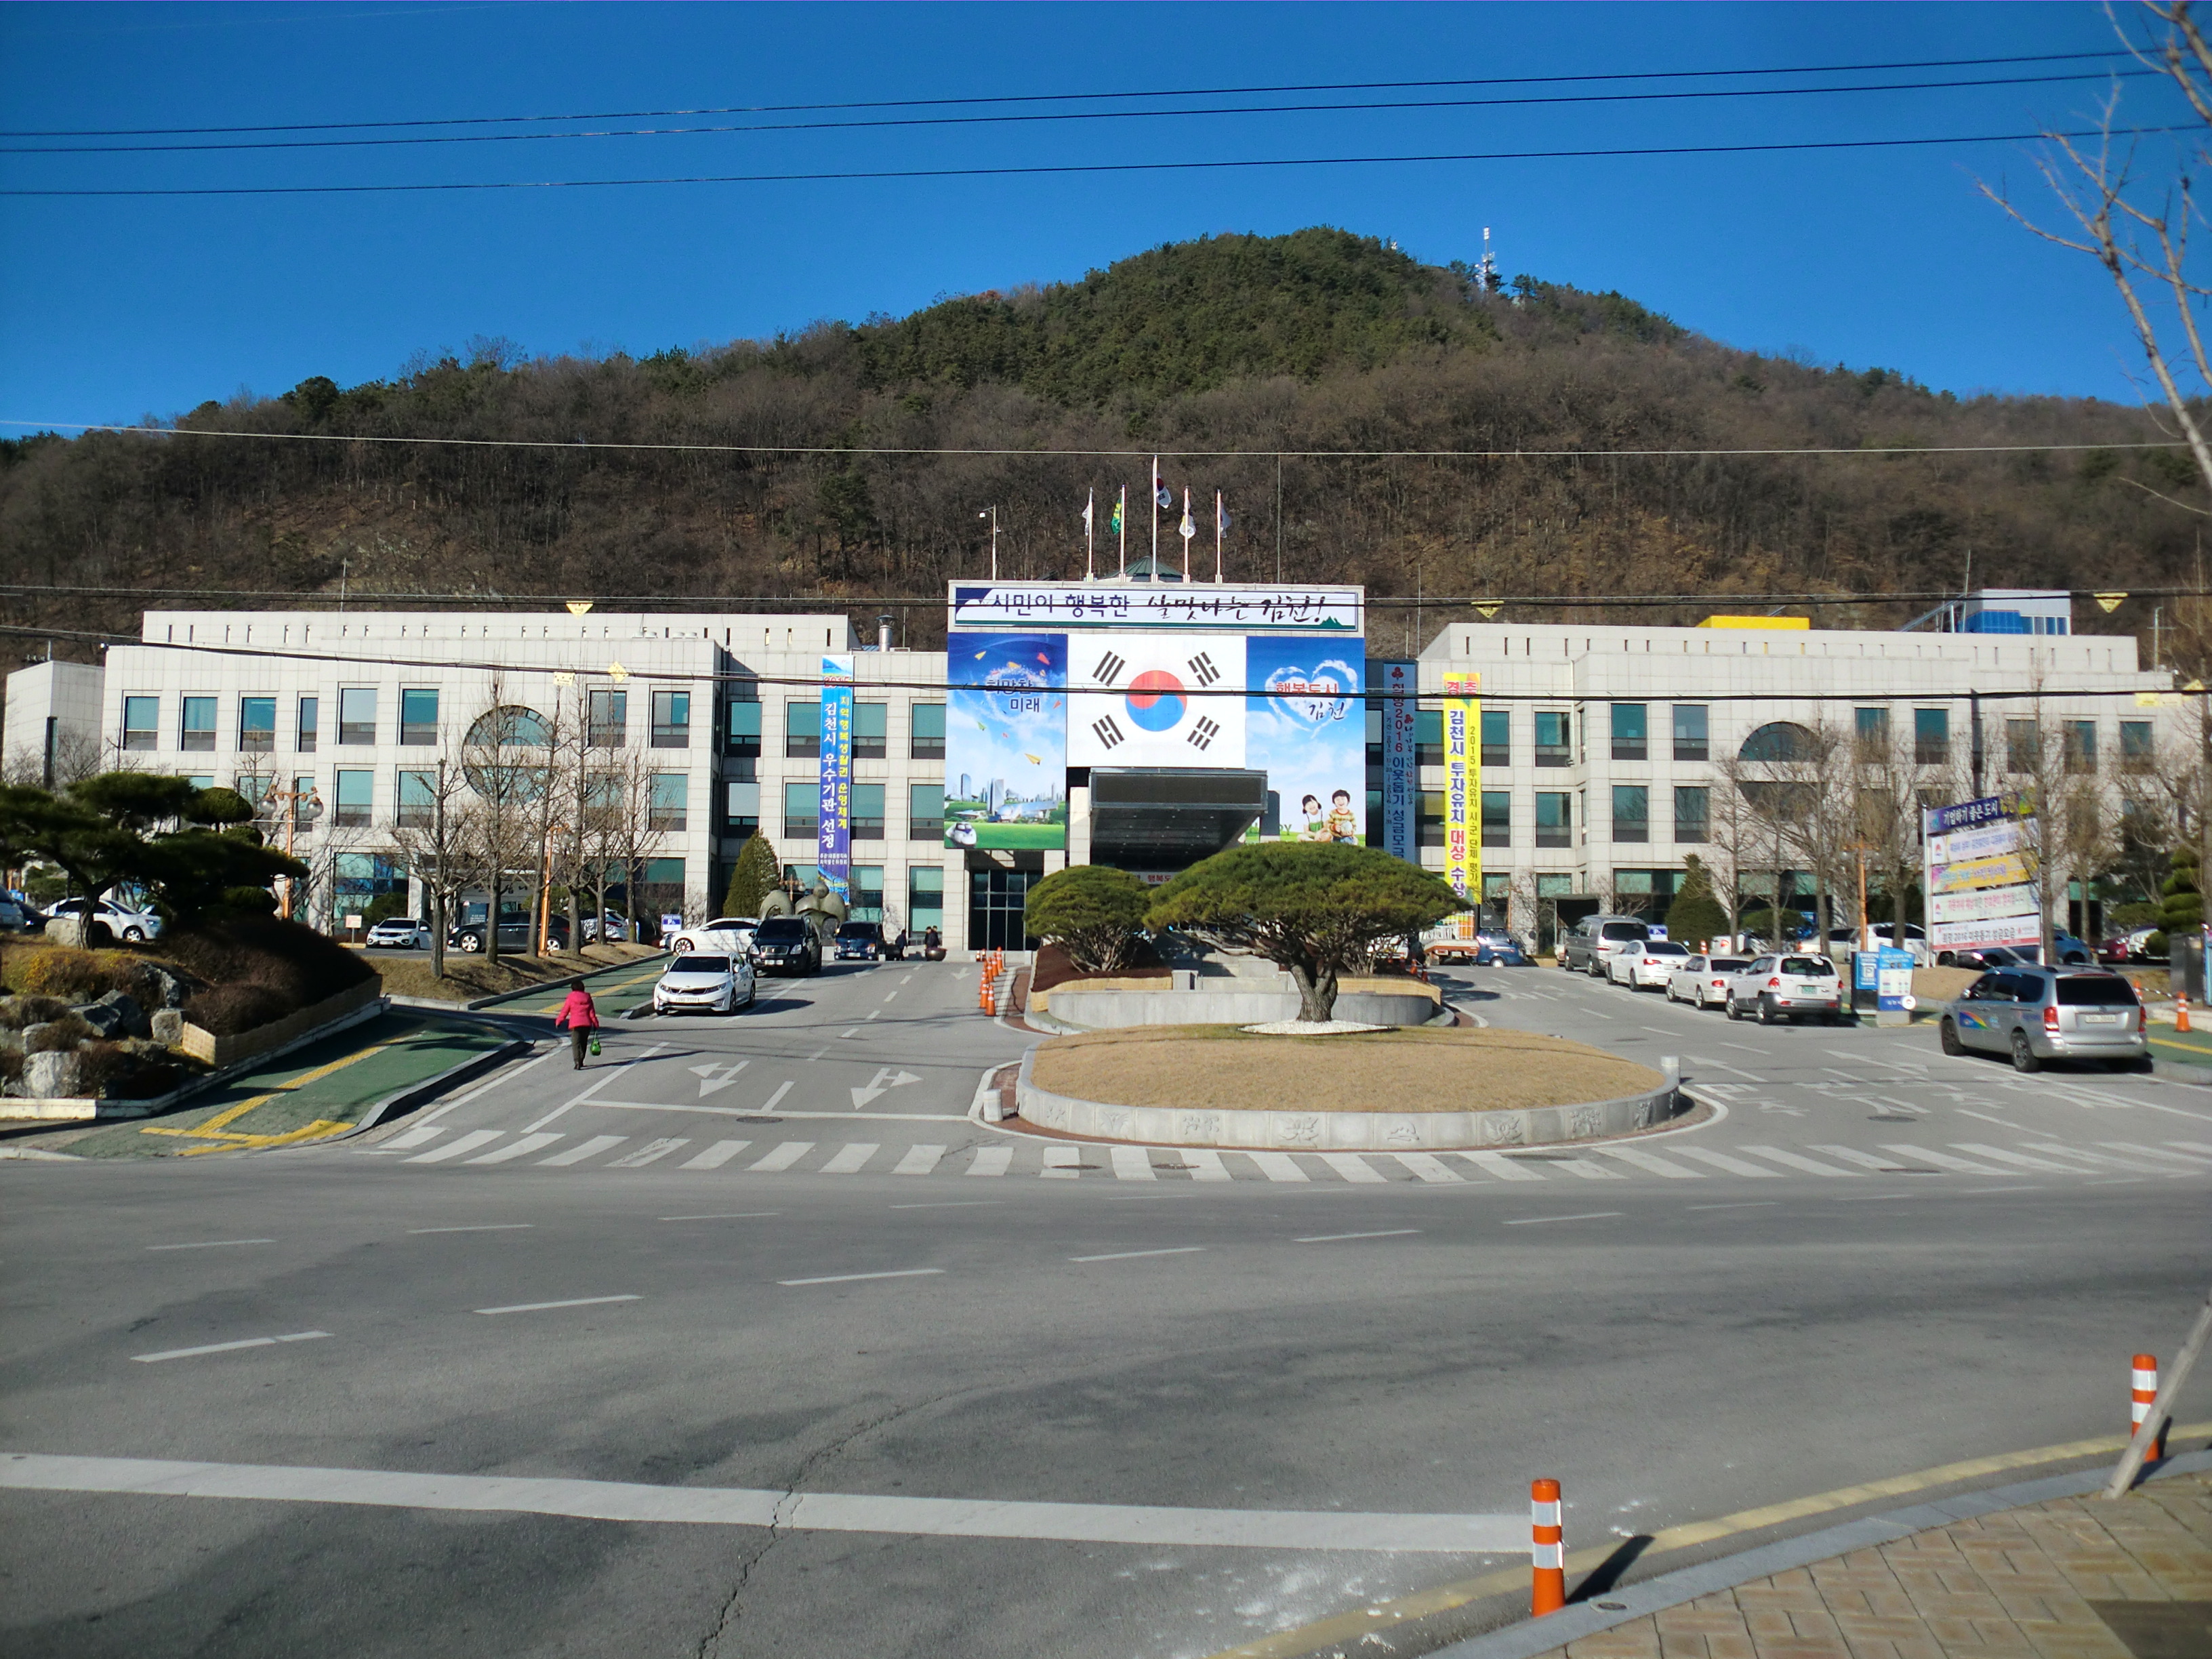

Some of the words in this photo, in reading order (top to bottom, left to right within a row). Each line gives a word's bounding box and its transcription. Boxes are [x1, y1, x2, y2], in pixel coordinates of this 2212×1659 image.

[992, 593, 1053, 617] 시민이
[1065, 594, 1130, 618] 행복한
[1010, 697, 1040, 713] 미래
[1275, 682, 1338, 698] 행복도시
[823, 702, 838, 746] 김천시
[1309, 701, 1345, 720] 김천
[1449, 710, 1465, 756] 김천시
[821, 752, 838, 813] 우수기관
[1450, 762, 1465, 824] 투자유치
[1469, 769, 1478, 808] 투자유치
[837, 781, 848, 830] 운영체계
[1944, 806, 1968, 826] 기업하기
[1970, 804, 1984, 822] 좋은
[1984, 800, 1999, 816] 도시
[821, 818, 836, 849] 선정
[1450, 829, 1465, 861] 대상
[1450, 867, 1466, 899] 수상
[1469, 862, 1479, 882] 평가
